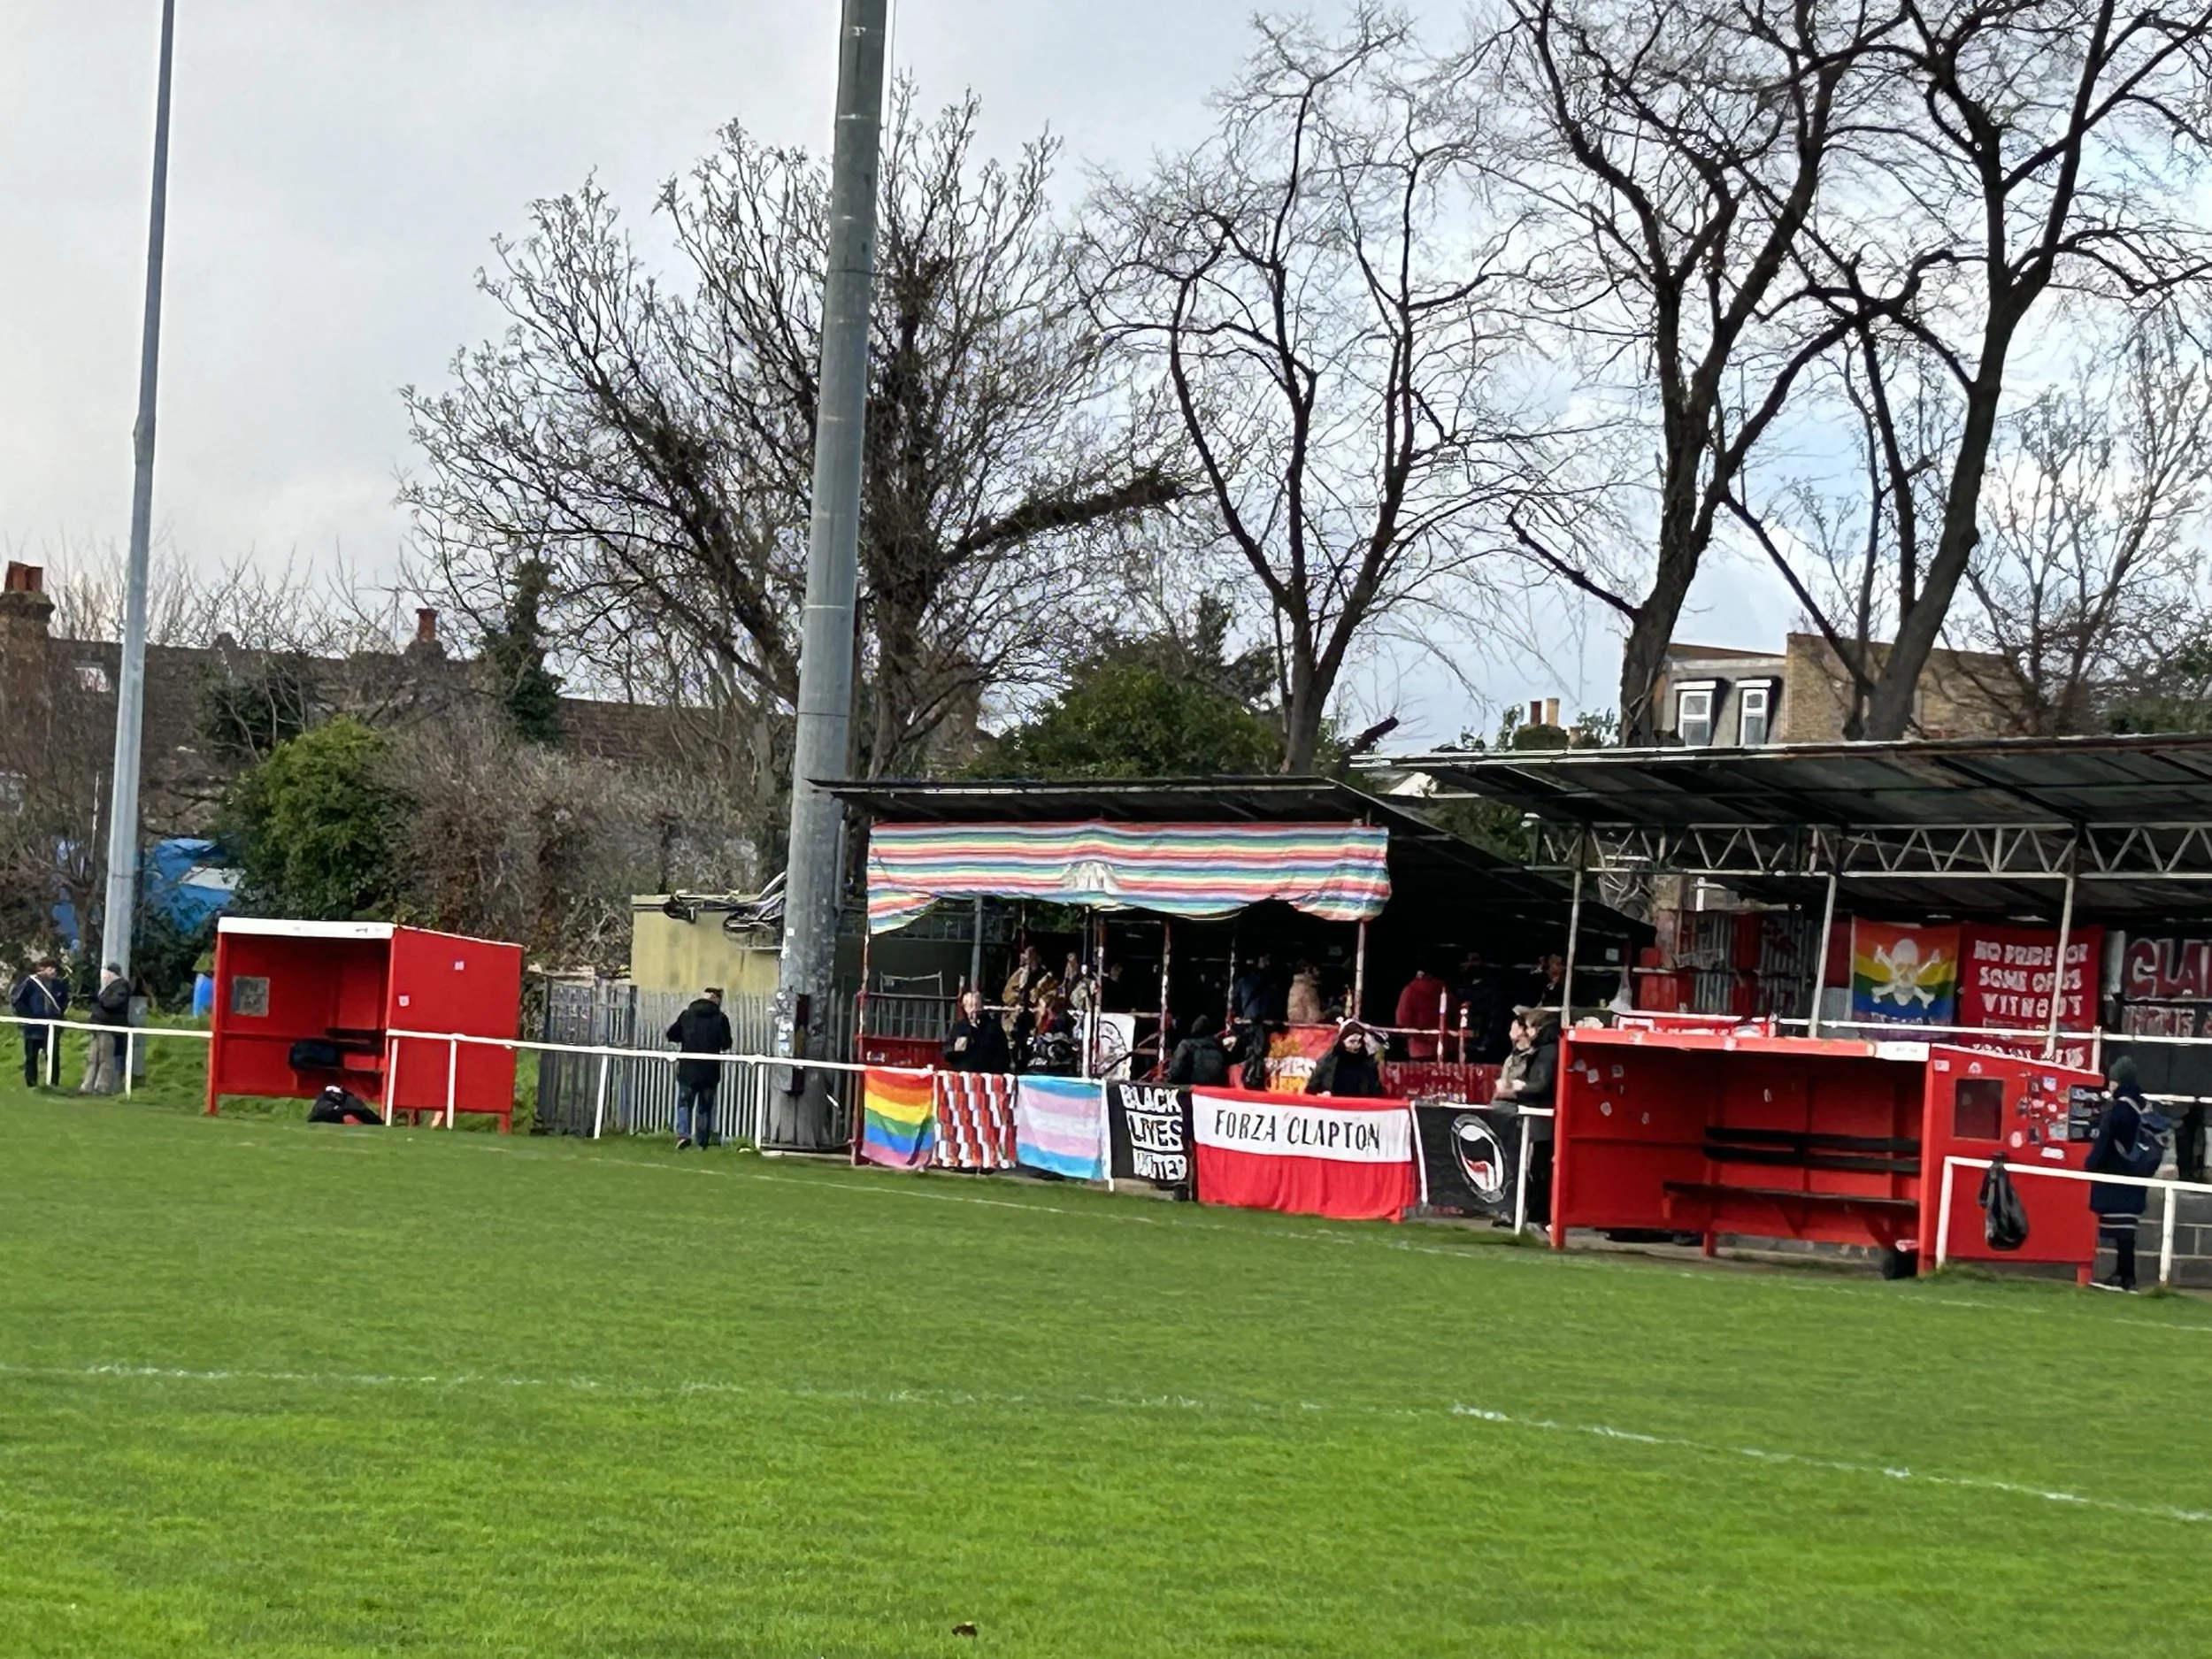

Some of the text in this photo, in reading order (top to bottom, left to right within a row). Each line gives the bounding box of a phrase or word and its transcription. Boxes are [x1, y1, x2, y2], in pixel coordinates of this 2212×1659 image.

[1973, 940, 2001, 962] NO
[2004, 944, 2054, 966] PRIDE
[1978, 966, 2028, 992] SOME
[2124, 938, 2212, 1000] CLA
[1981, 992, 2083, 1018] WITHOUT
[1119, 1084, 1183, 1113] BLACK
[1128, 1114, 1182, 1147] LIVES
[1215, 1109, 1380, 1150] FORZA CLAPTON
